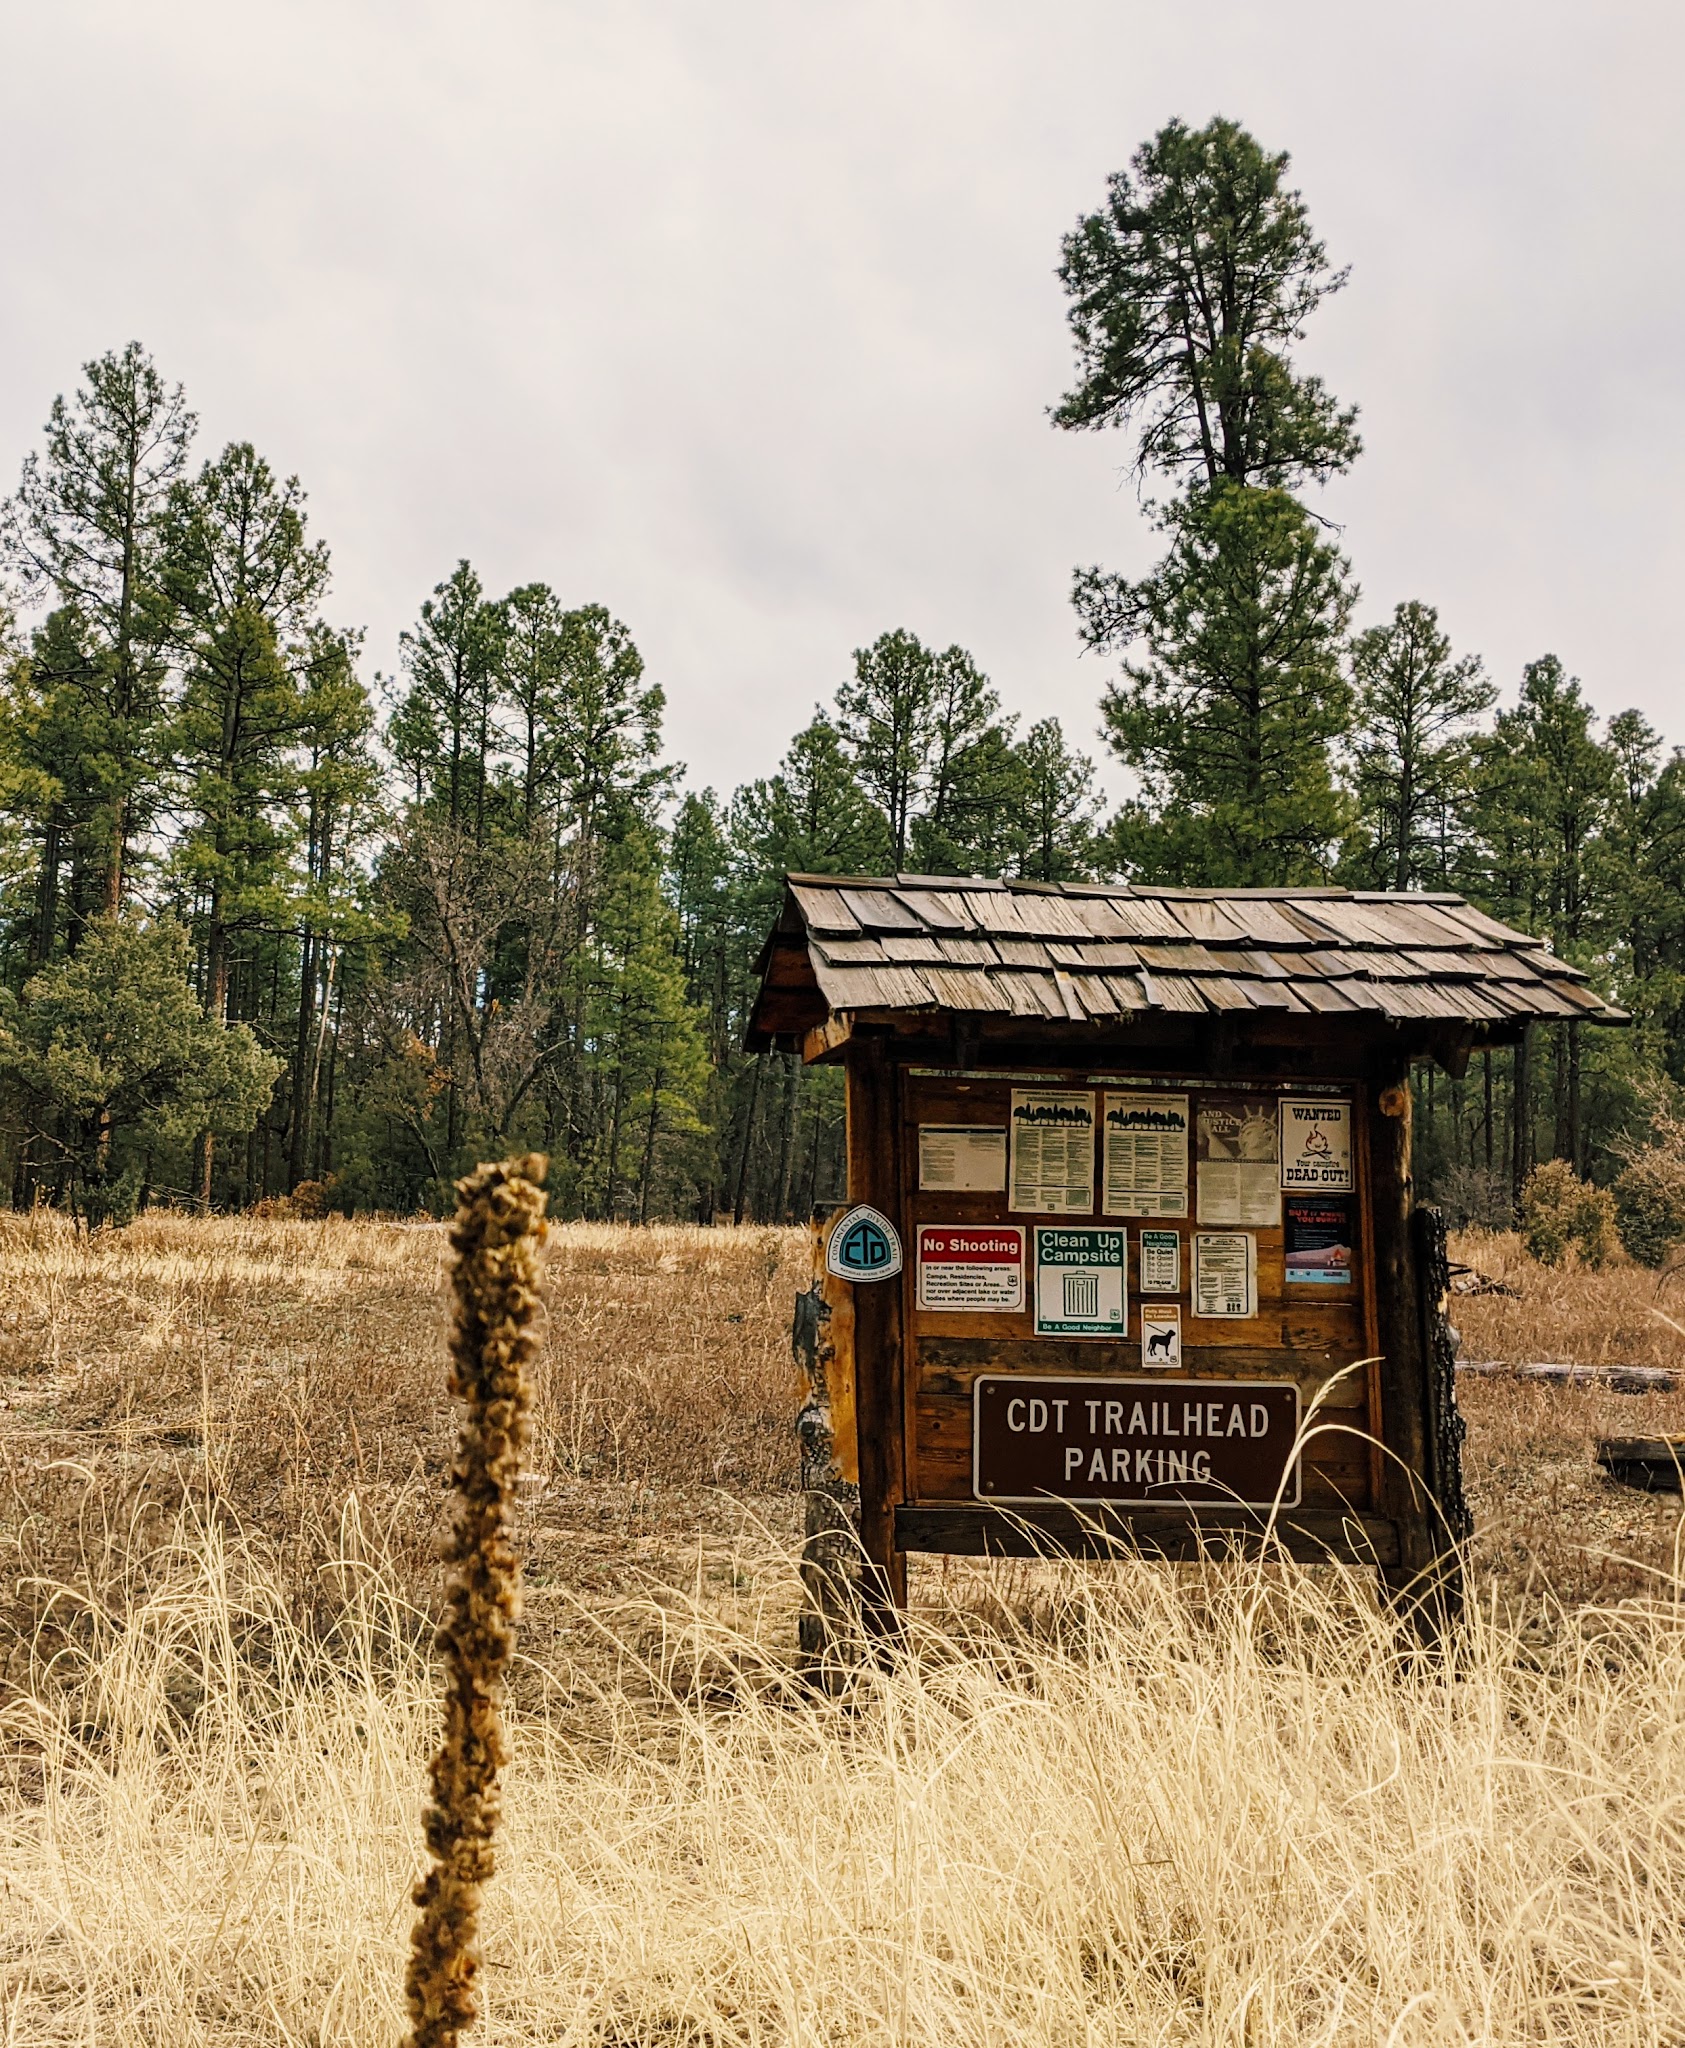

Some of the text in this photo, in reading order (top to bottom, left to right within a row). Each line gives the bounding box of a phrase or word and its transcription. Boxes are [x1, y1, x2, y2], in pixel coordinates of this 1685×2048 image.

[1201, 1110, 1222, 1118] AND
[1292, 1107, 1341, 1121] WANTED
[1211, 1125, 1230, 1133] ALL
[866, 1212, 892, 1234] DIVIDE
[832, 1214, 861, 1260] CONTINENTAL
[1041, 1232, 1120, 1250] Clean Up
[889, 1236, 898, 1260] TRAIL
[923, 1238, 1019, 1255] No Shooting
[1041, 1248, 1120, 1264] Campsite
[966, 1265, 993, 1273] following
[952, 1289, 977, 1297] adjacent
[1082, 1324, 1112, 1332] Neighbor
[1007, 1399, 1269, 1438] CDT TRAILHEAD
[1065, 1447, 1211, 1483] PARKING
